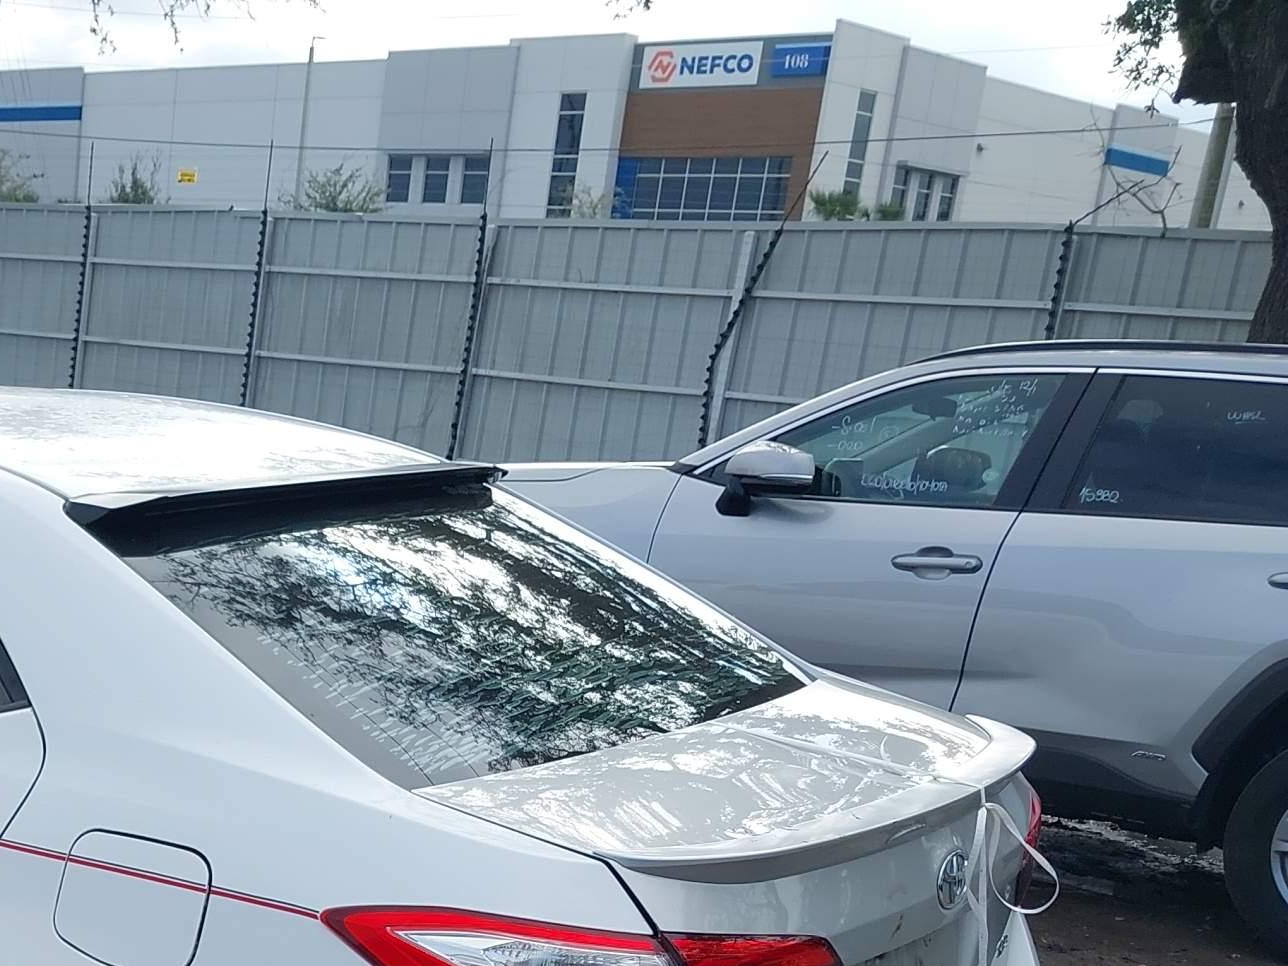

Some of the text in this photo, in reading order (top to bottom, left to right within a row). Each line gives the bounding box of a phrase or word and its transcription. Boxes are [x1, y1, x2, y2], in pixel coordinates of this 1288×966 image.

[679, 53, 754, 76] NEFCO
[783, 53, 809, 70] 108
[1079, 487, 1119, 504] 15982
